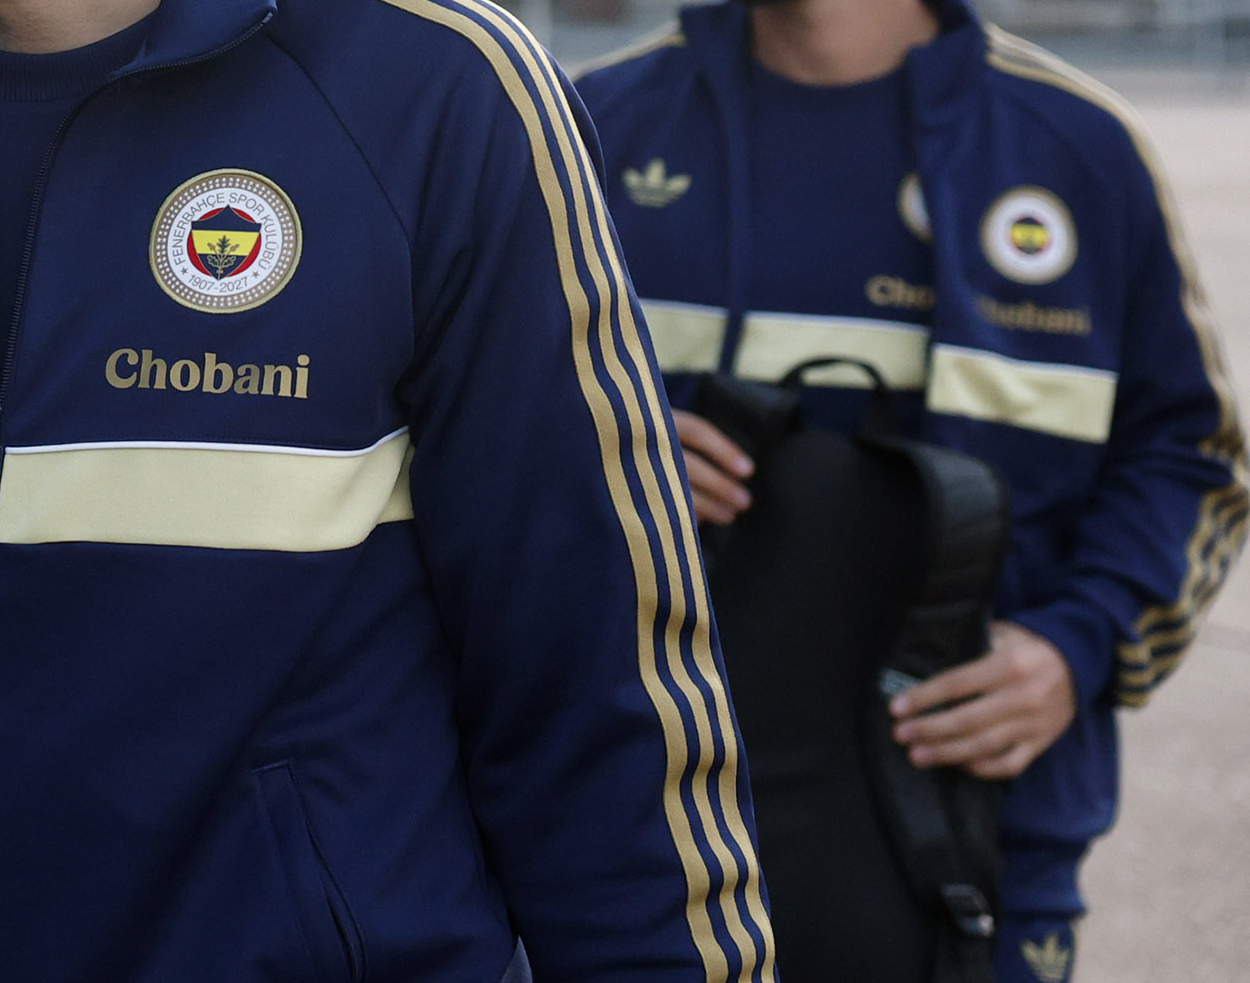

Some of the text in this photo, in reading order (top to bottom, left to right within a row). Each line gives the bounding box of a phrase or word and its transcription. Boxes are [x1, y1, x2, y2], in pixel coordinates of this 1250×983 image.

[175, 192, 279, 270] FENERBAHÇE SPOR KULÜBÜ
[188, 274, 248, 293] 1907-2027
[105, 348, 310, 399] Chobani
